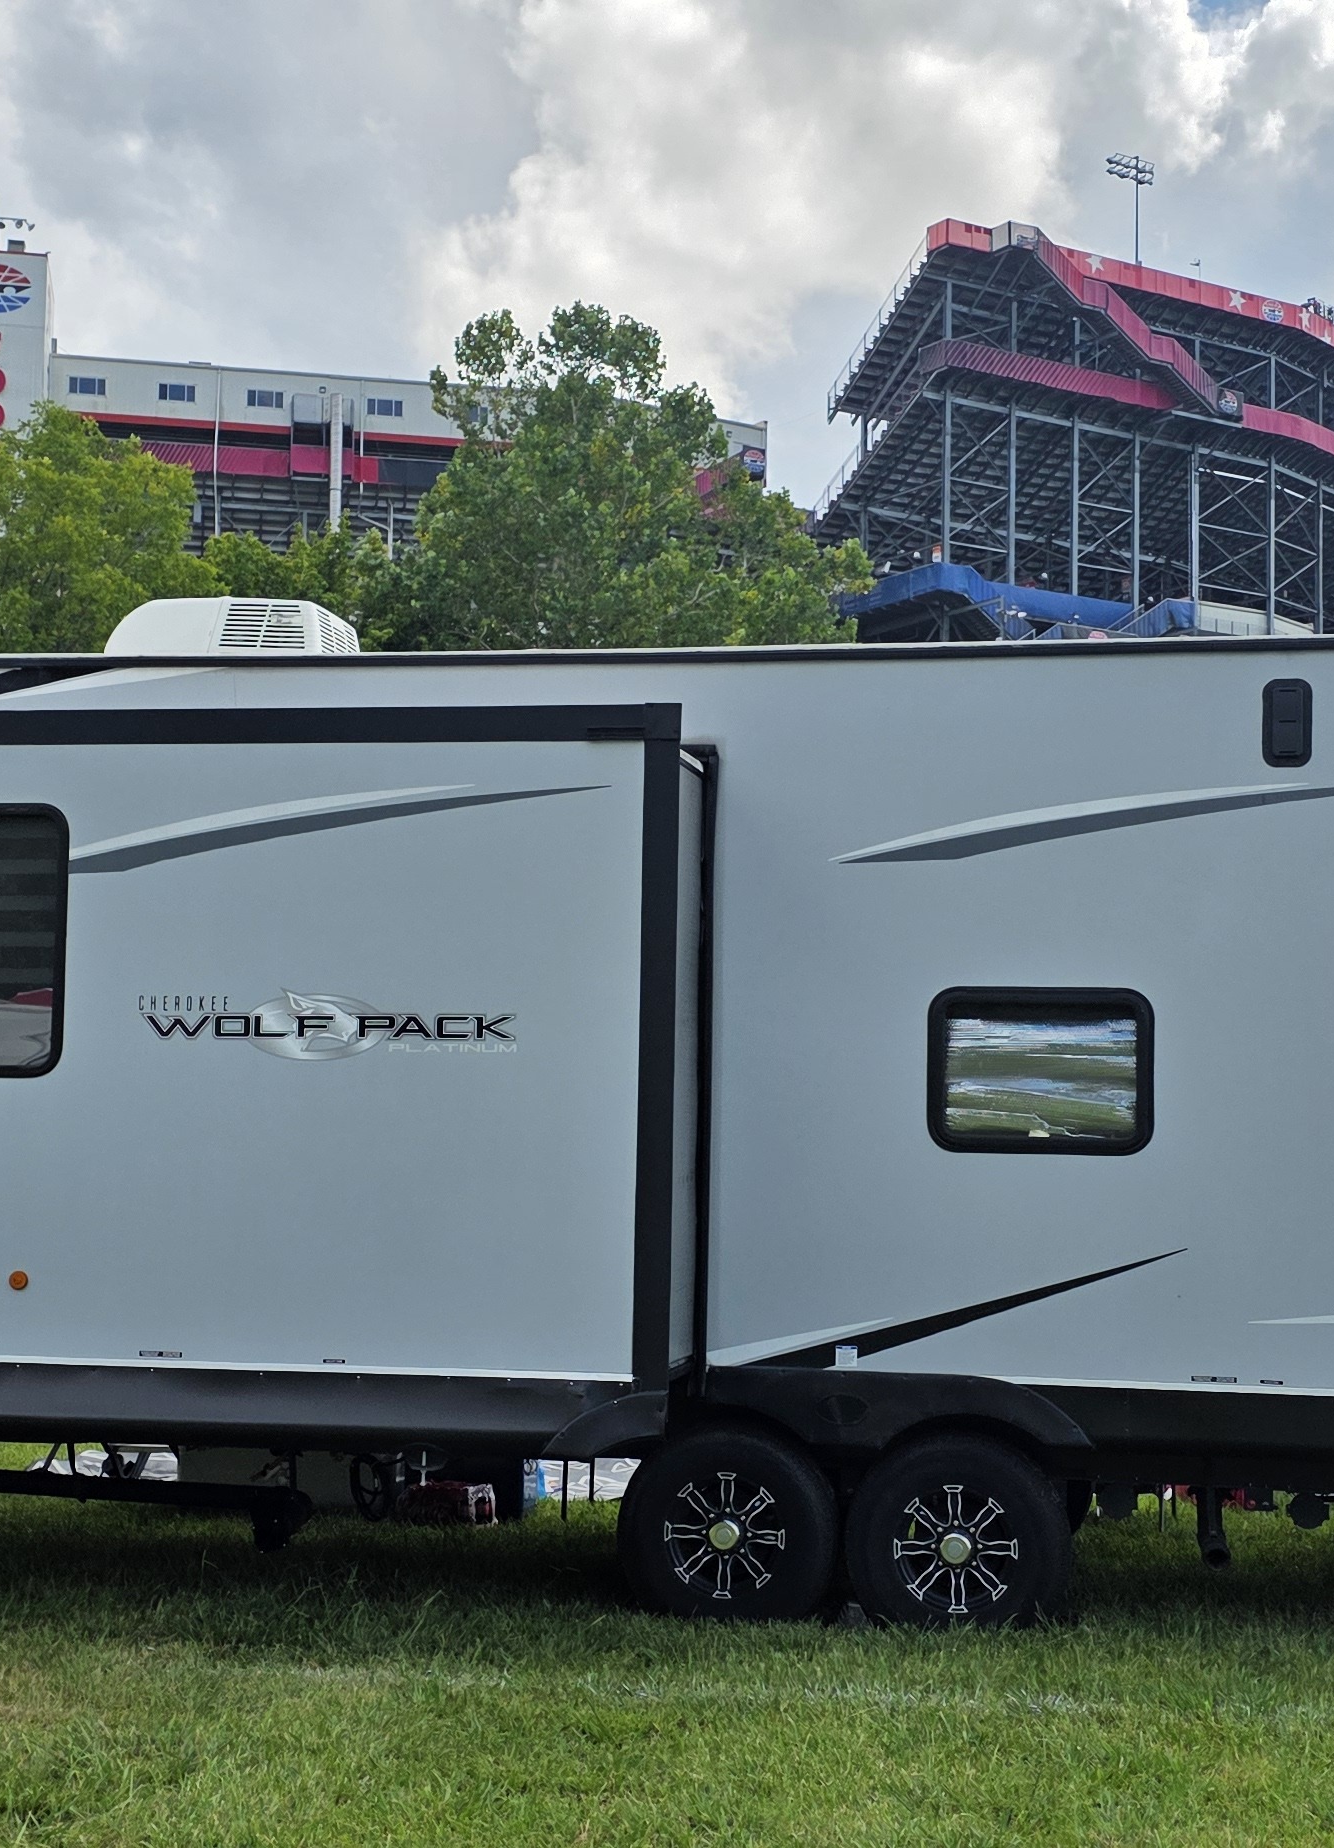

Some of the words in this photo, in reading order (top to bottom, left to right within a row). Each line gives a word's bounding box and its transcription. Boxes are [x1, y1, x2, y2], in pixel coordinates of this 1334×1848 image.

[138, 995, 229, 1012] CHEROKEE
[142, 1013, 336, 1040] WOLF
[351, 1014, 516, 1041] PACK
[388, 1043, 517, 1053] PLATINUM
